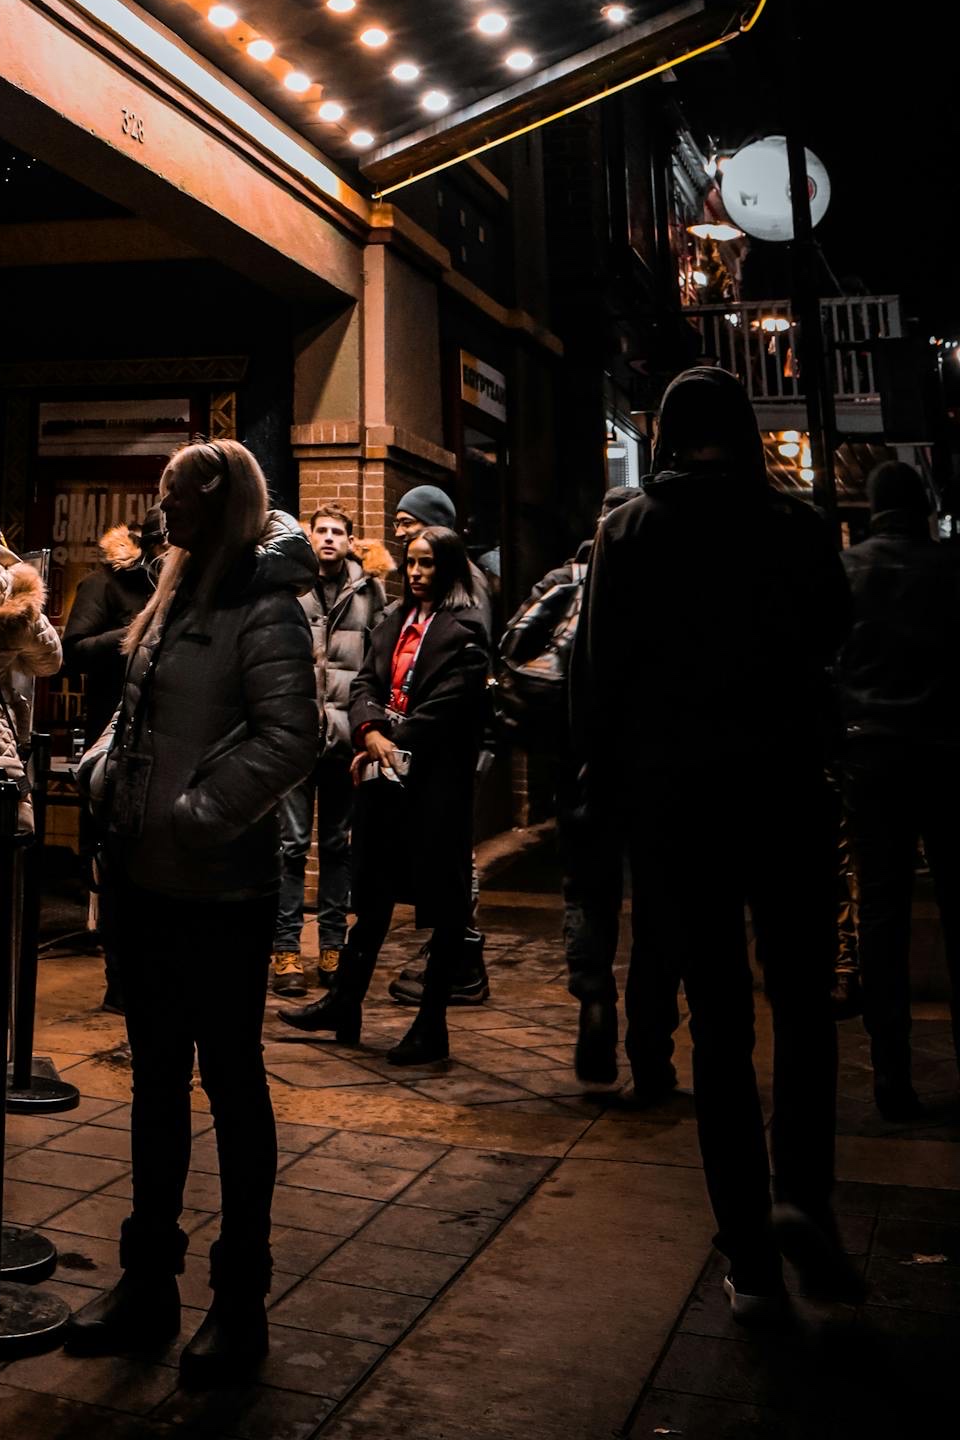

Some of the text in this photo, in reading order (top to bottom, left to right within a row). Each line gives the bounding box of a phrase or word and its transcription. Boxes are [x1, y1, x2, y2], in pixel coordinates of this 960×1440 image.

[121, 107, 144, 144] 328
[52, 493, 161, 543] CHALLEN
[52, 545, 110, 566] QUE
